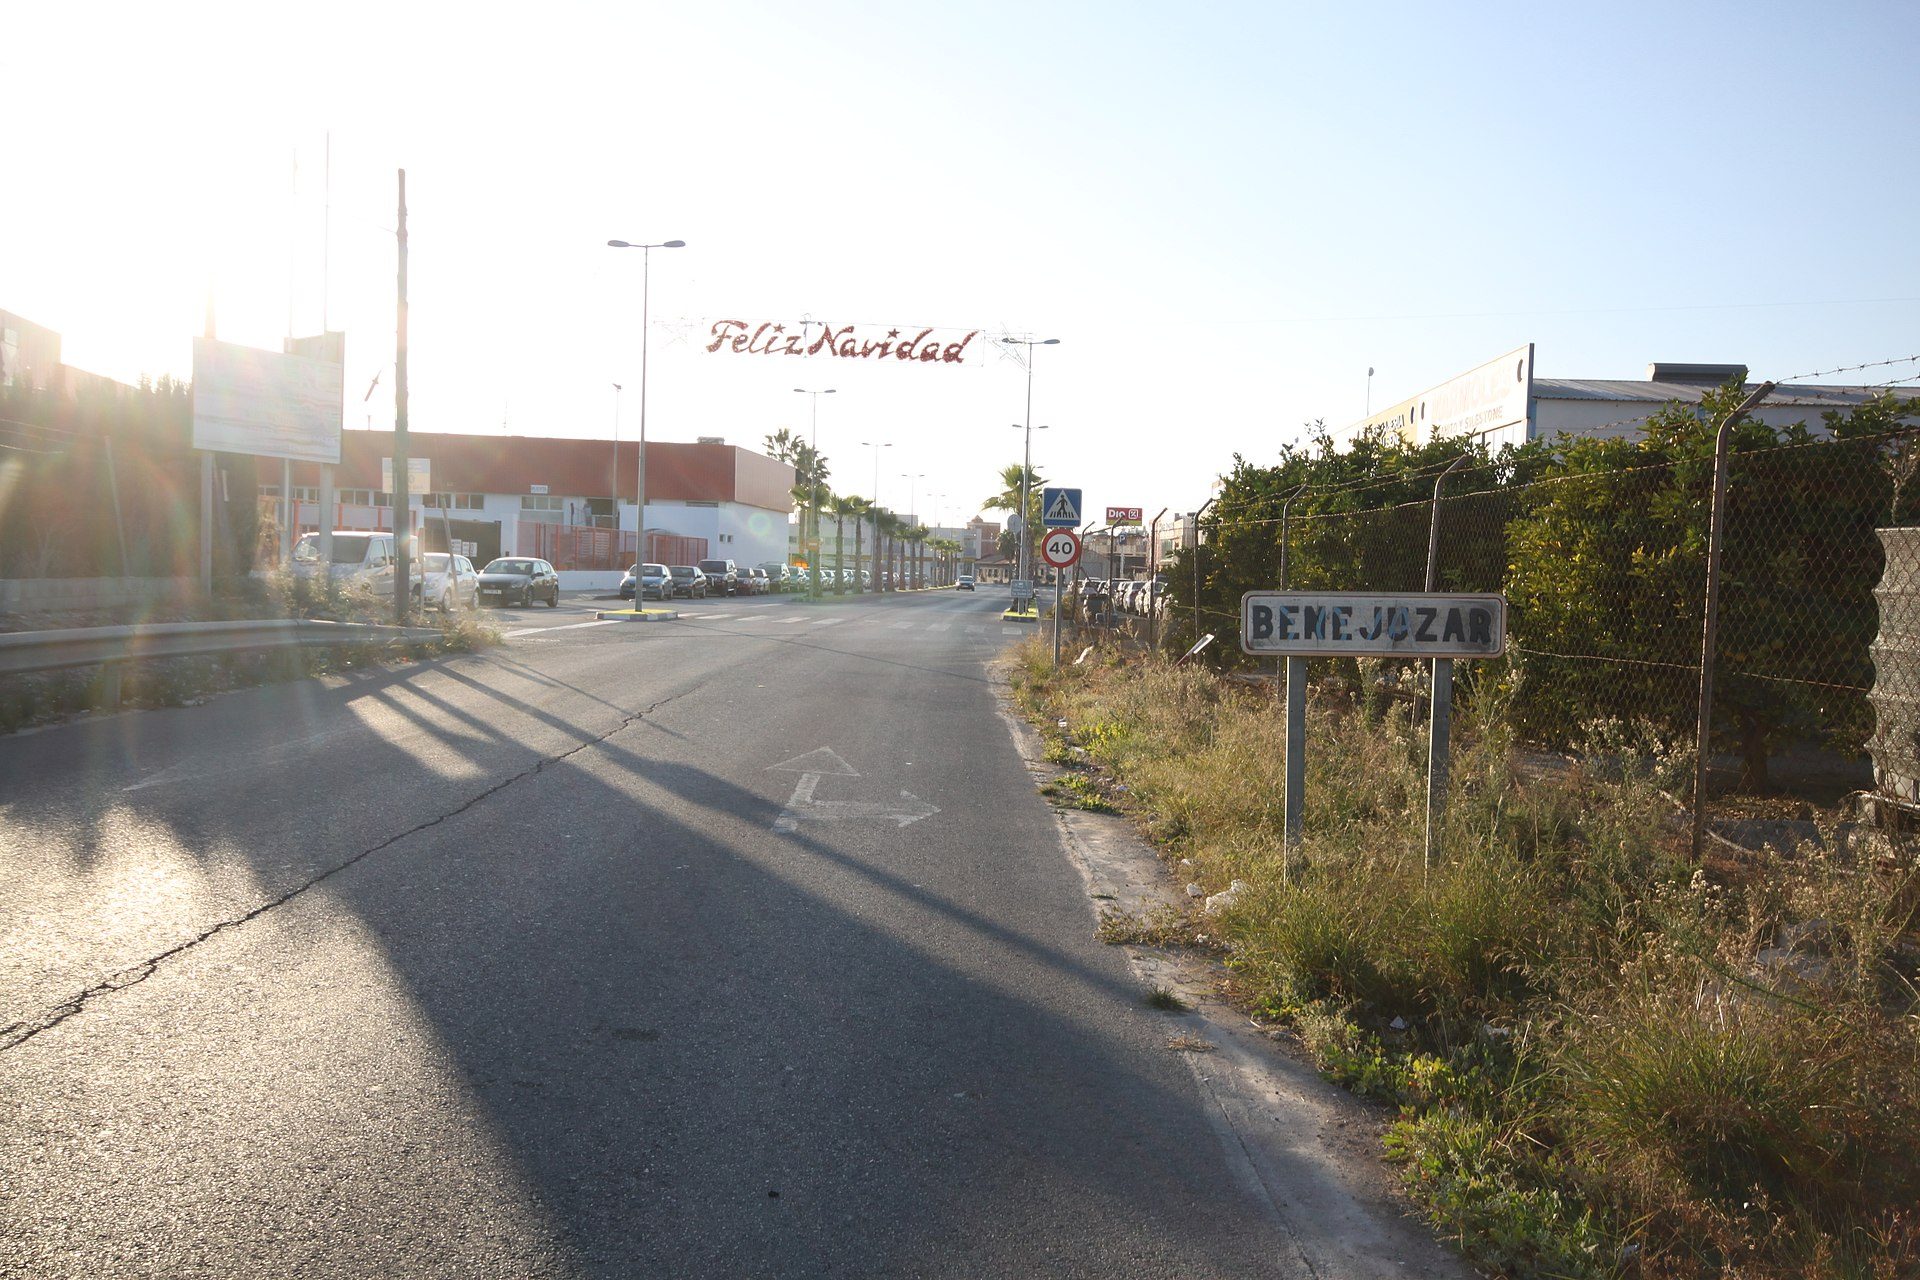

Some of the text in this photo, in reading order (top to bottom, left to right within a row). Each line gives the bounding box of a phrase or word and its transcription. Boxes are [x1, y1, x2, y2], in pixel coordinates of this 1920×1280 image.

[706, 319, 980, 363] Feliz Navidad
[1049, 541, 1073, 555] 40
